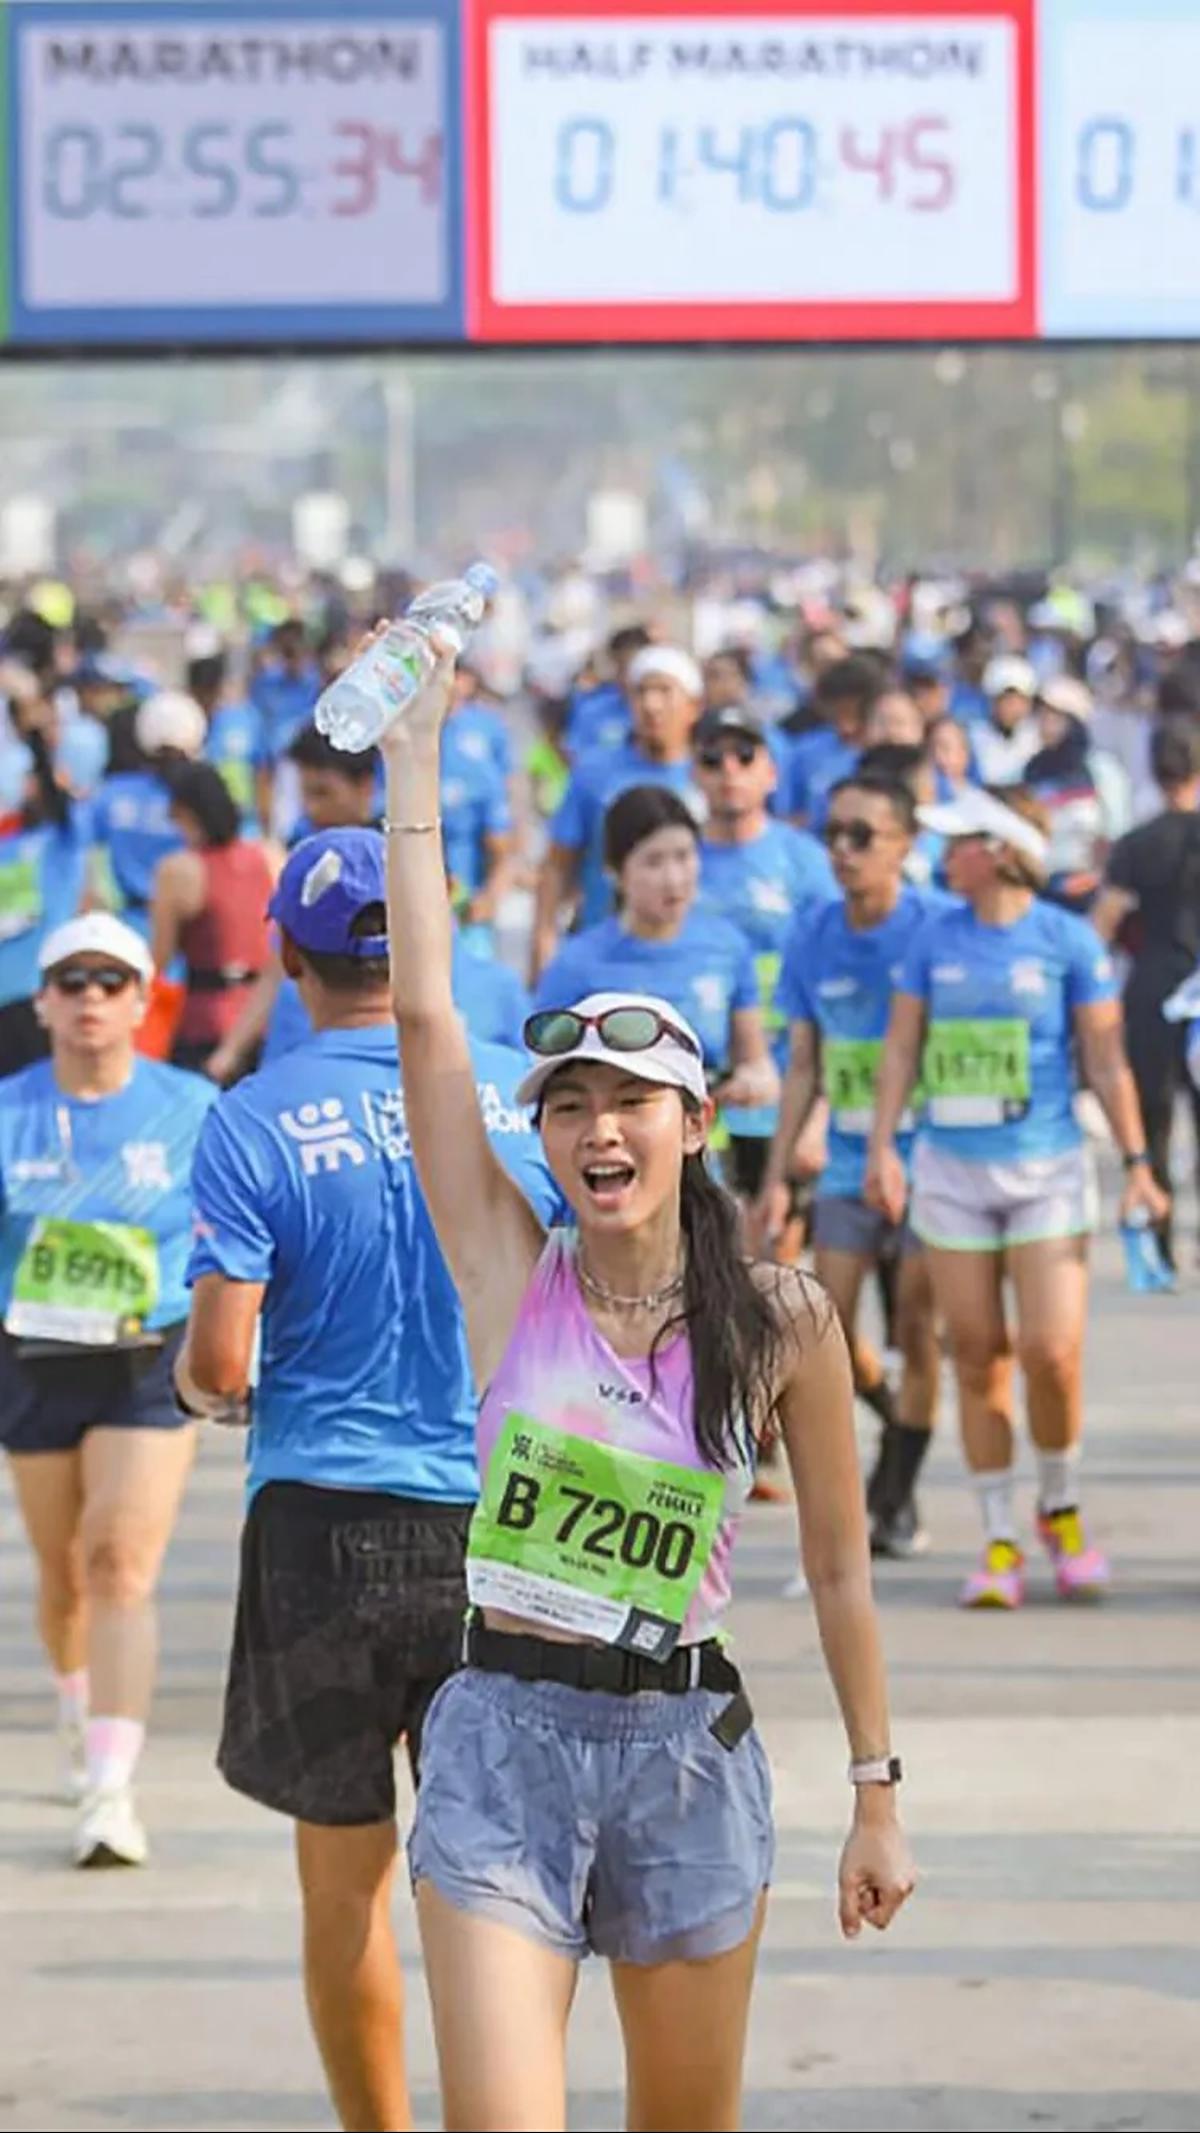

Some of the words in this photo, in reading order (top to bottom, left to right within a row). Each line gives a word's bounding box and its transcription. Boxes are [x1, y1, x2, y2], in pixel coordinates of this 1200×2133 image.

[44, 38, 419, 82] MARATHON
[522, 40, 652, 80] HALF
[667, 40, 986, 80] MARATHON
[646, 1489, 703, 1519] FEMALE
[496, 1470, 541, 1531] B
[554, 1485, 696, 1581] 7200
